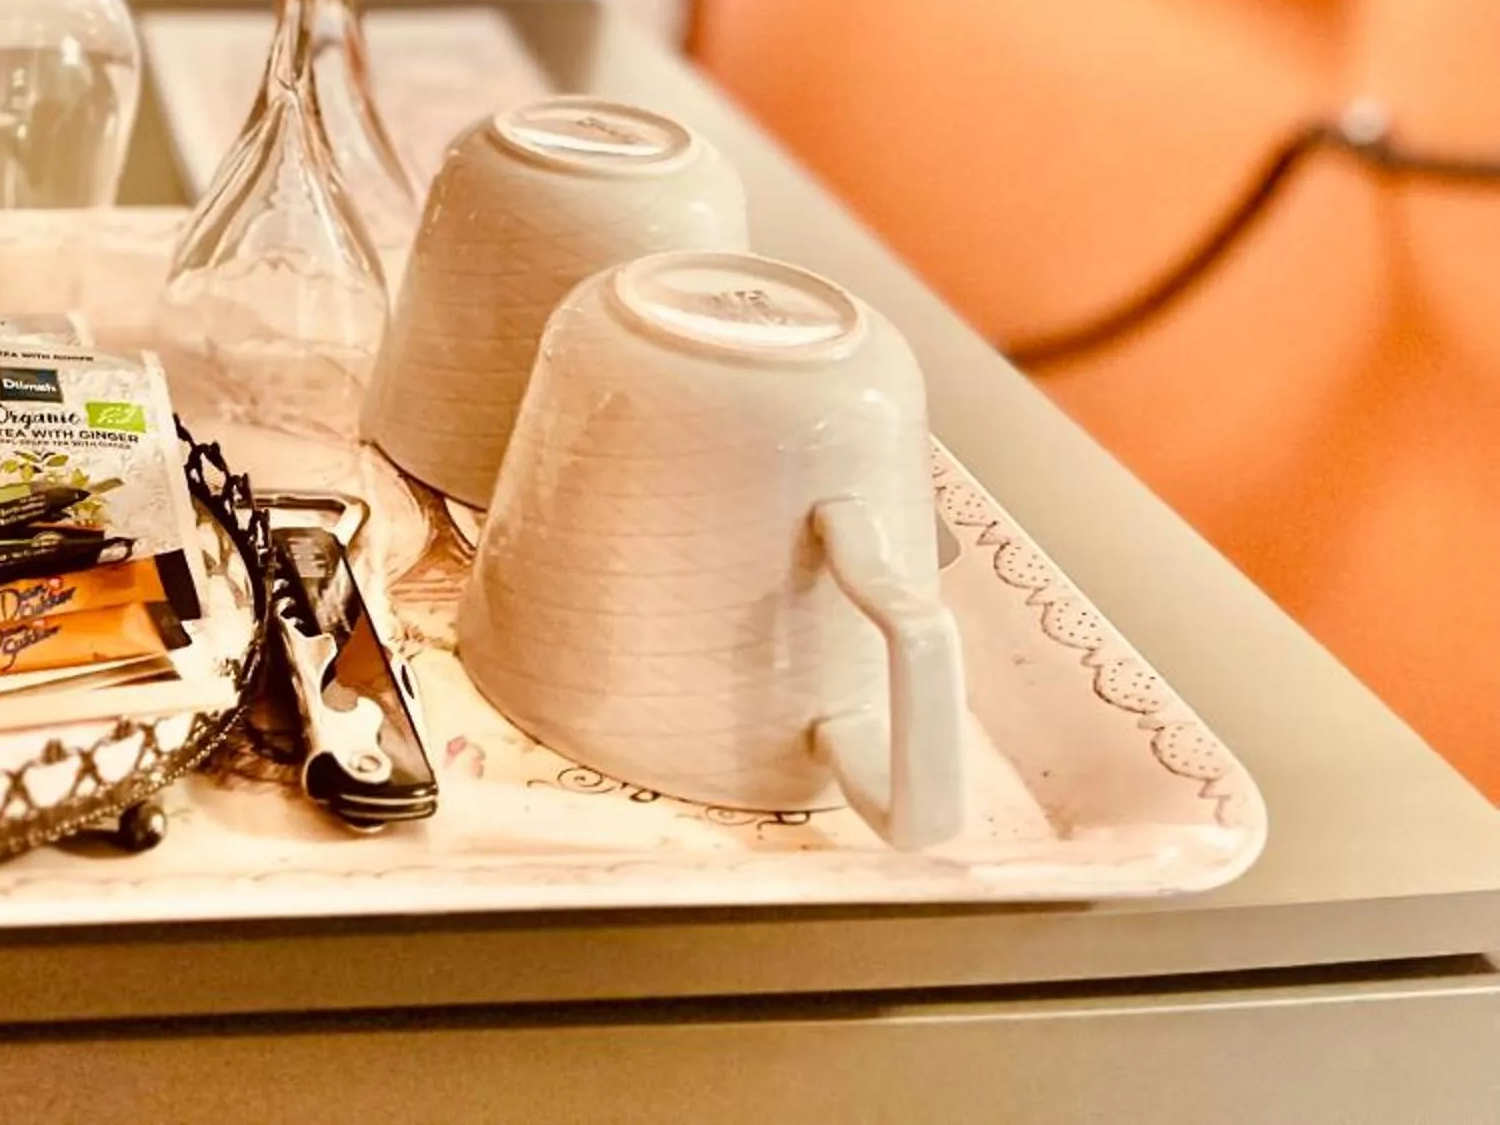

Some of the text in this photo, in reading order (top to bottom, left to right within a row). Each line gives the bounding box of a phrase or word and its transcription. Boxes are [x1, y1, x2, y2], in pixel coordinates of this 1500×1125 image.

[2, 377, 57, 394] Dilmah
[32, 430, 74, 440] WITH
[79, 431, 139, 444] GINGER
